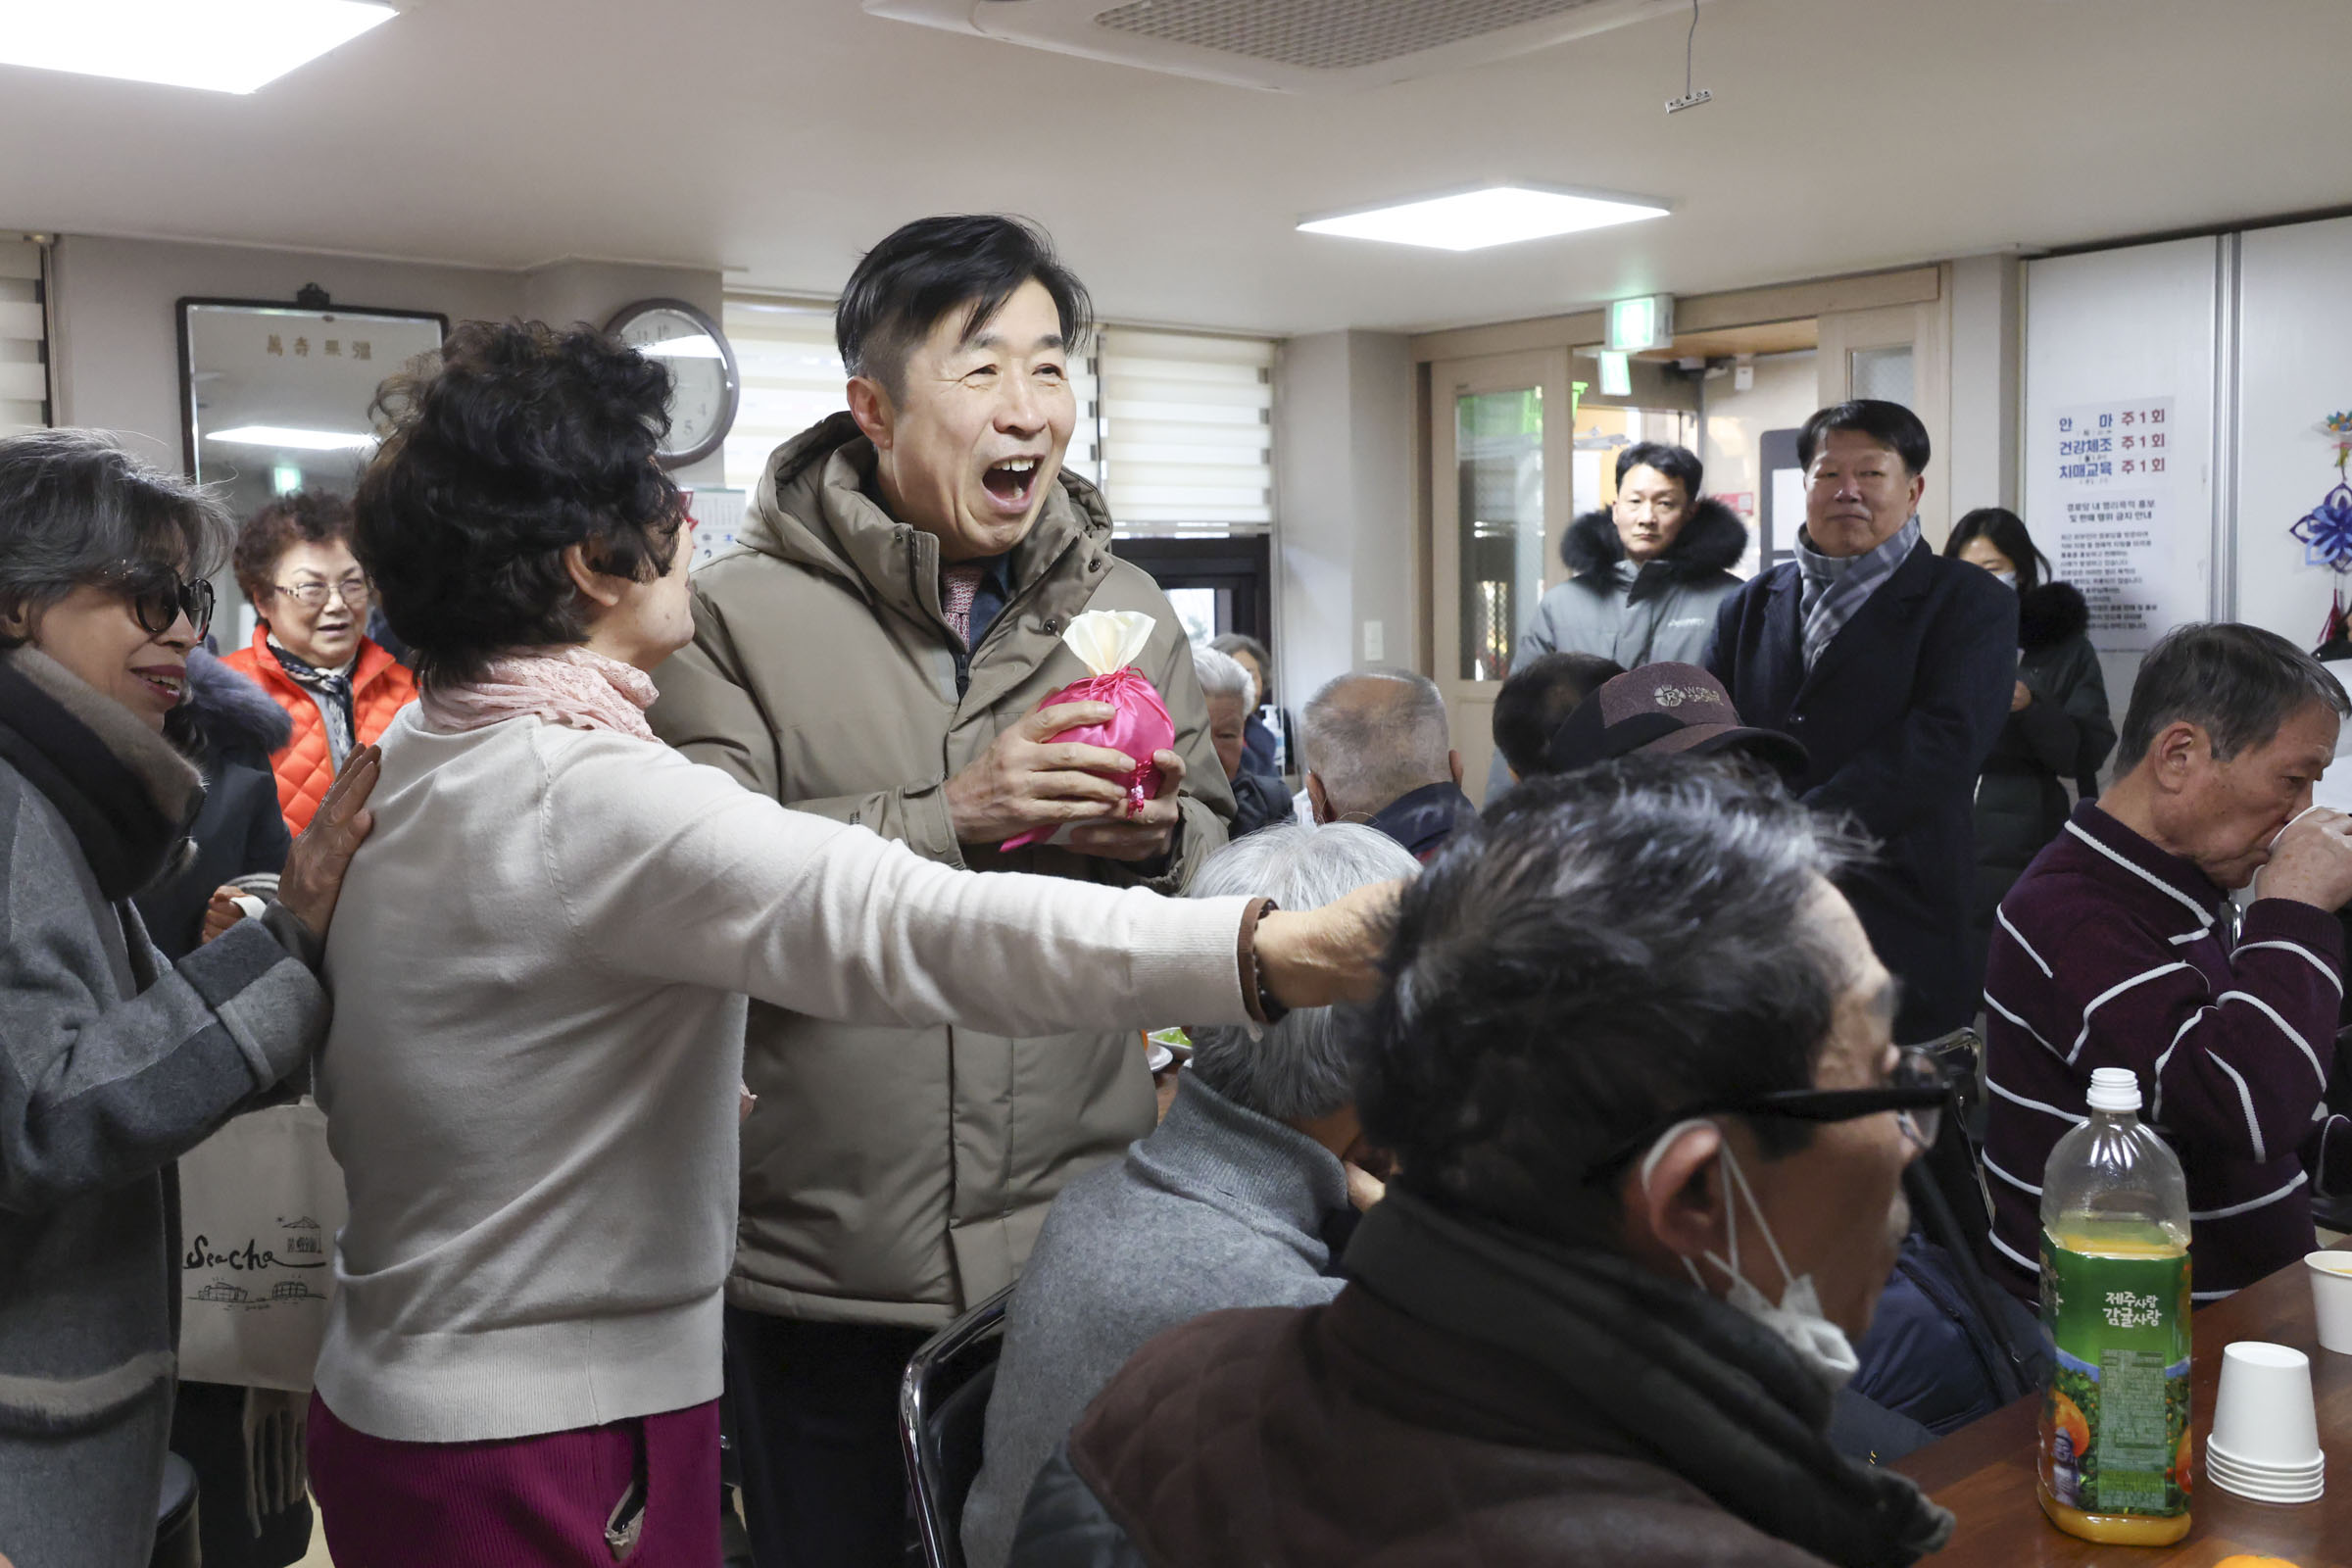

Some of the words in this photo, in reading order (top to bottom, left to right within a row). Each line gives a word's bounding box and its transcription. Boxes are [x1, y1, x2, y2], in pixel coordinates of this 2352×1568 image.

[2059, 437, 2113, 456] 건강체조
[2059, 462, 2113, 479] 치매교육
[2104, 1291, 2159, 1309] 제주사랑
[2101, 1306, 2163, 1328] 감귤사랑
